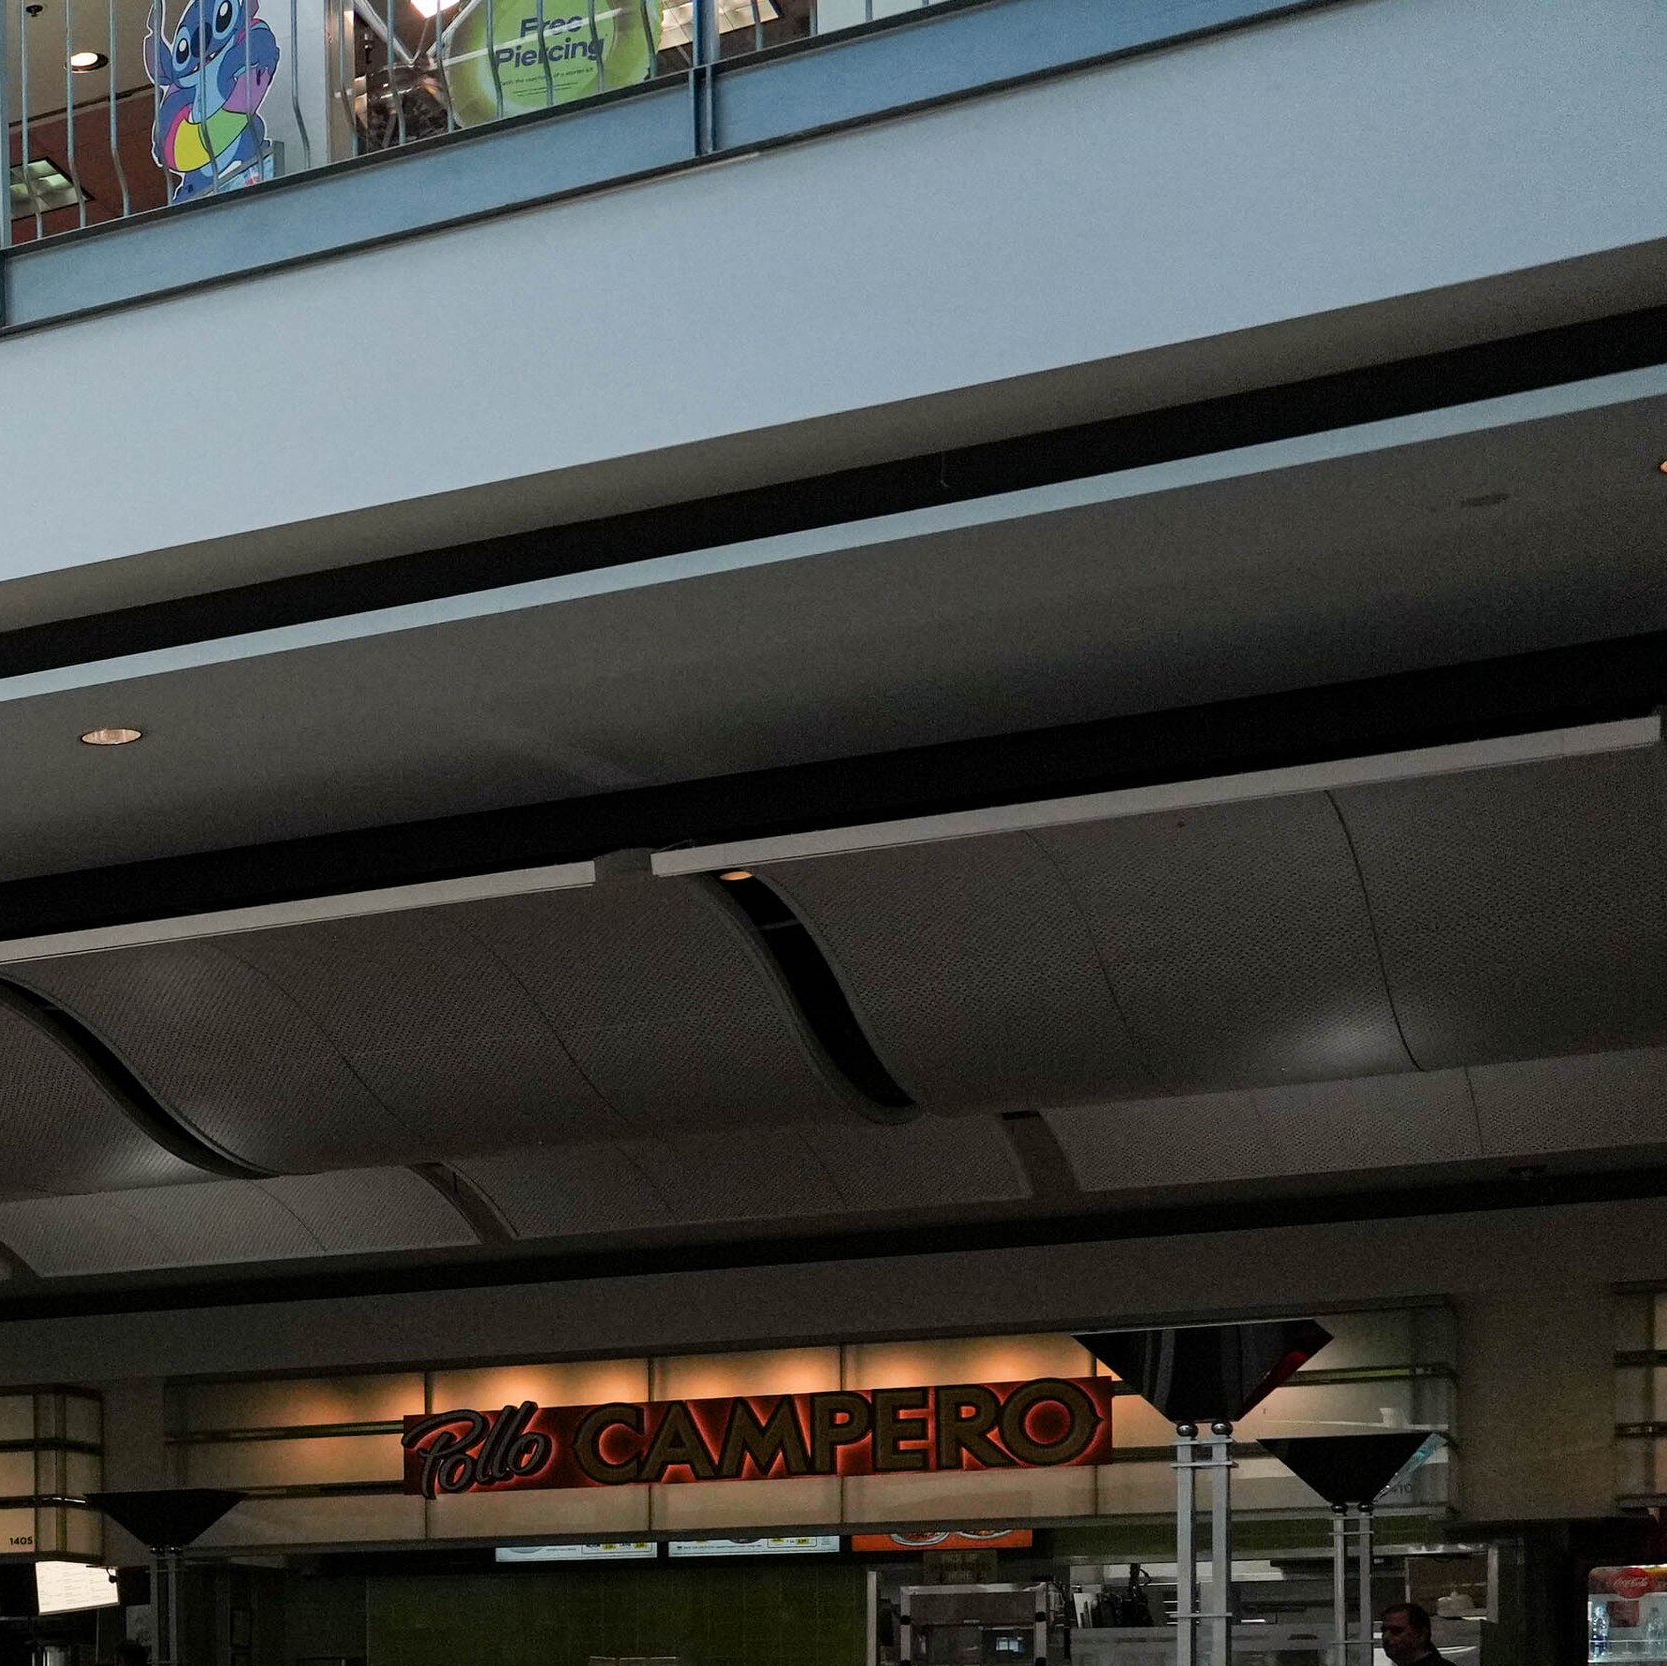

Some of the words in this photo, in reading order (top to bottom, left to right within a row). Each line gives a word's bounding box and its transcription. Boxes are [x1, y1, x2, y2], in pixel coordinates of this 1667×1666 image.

[495, 37, 604, 69] Piercing
[401, 1400, 554, 1498] Pollo
[573, 1377, 1104, 1486] CAMPERO
[10, 1536, 33, 1546] 1405
